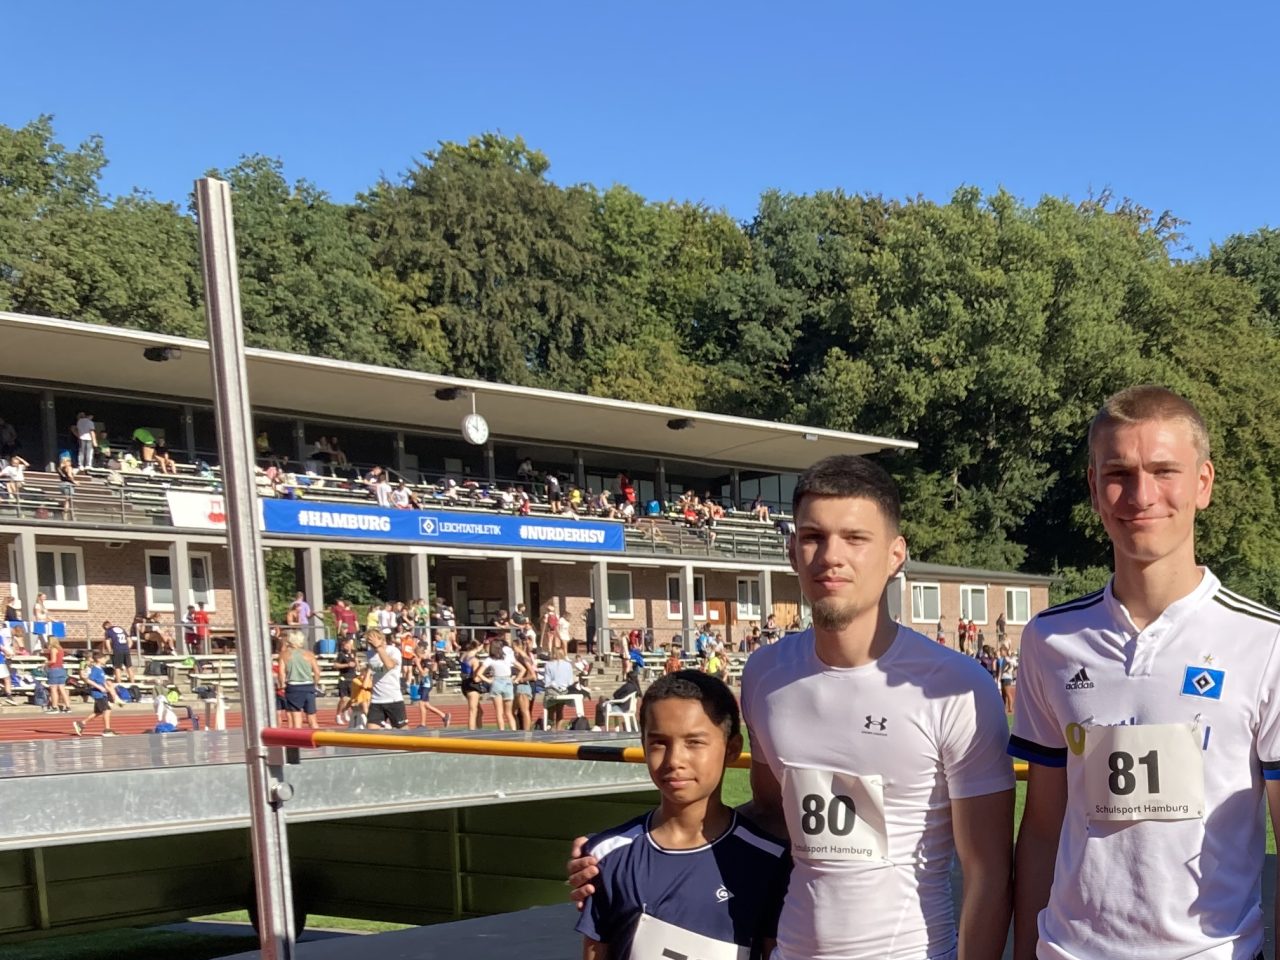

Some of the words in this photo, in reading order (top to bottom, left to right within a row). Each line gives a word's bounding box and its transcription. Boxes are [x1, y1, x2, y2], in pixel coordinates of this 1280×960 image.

[298, 510, 391, 531] #HAMBURG
[440, 522, 501, 536] LEICHTATHLETIK
[520, 525, 606, 543] #NURDERHSV
[1065, 682, 1095, 690] adidas
[1108, 750, 1160, 795] 81
[801, 793, 856, 836] 80
[1095, 804, 1141, 815] Schulsport
[1143, 804, 1189, 814] Hamburg
[794, 843, 828, 855] sport
[830, 845, 873, 857] Hamburg
